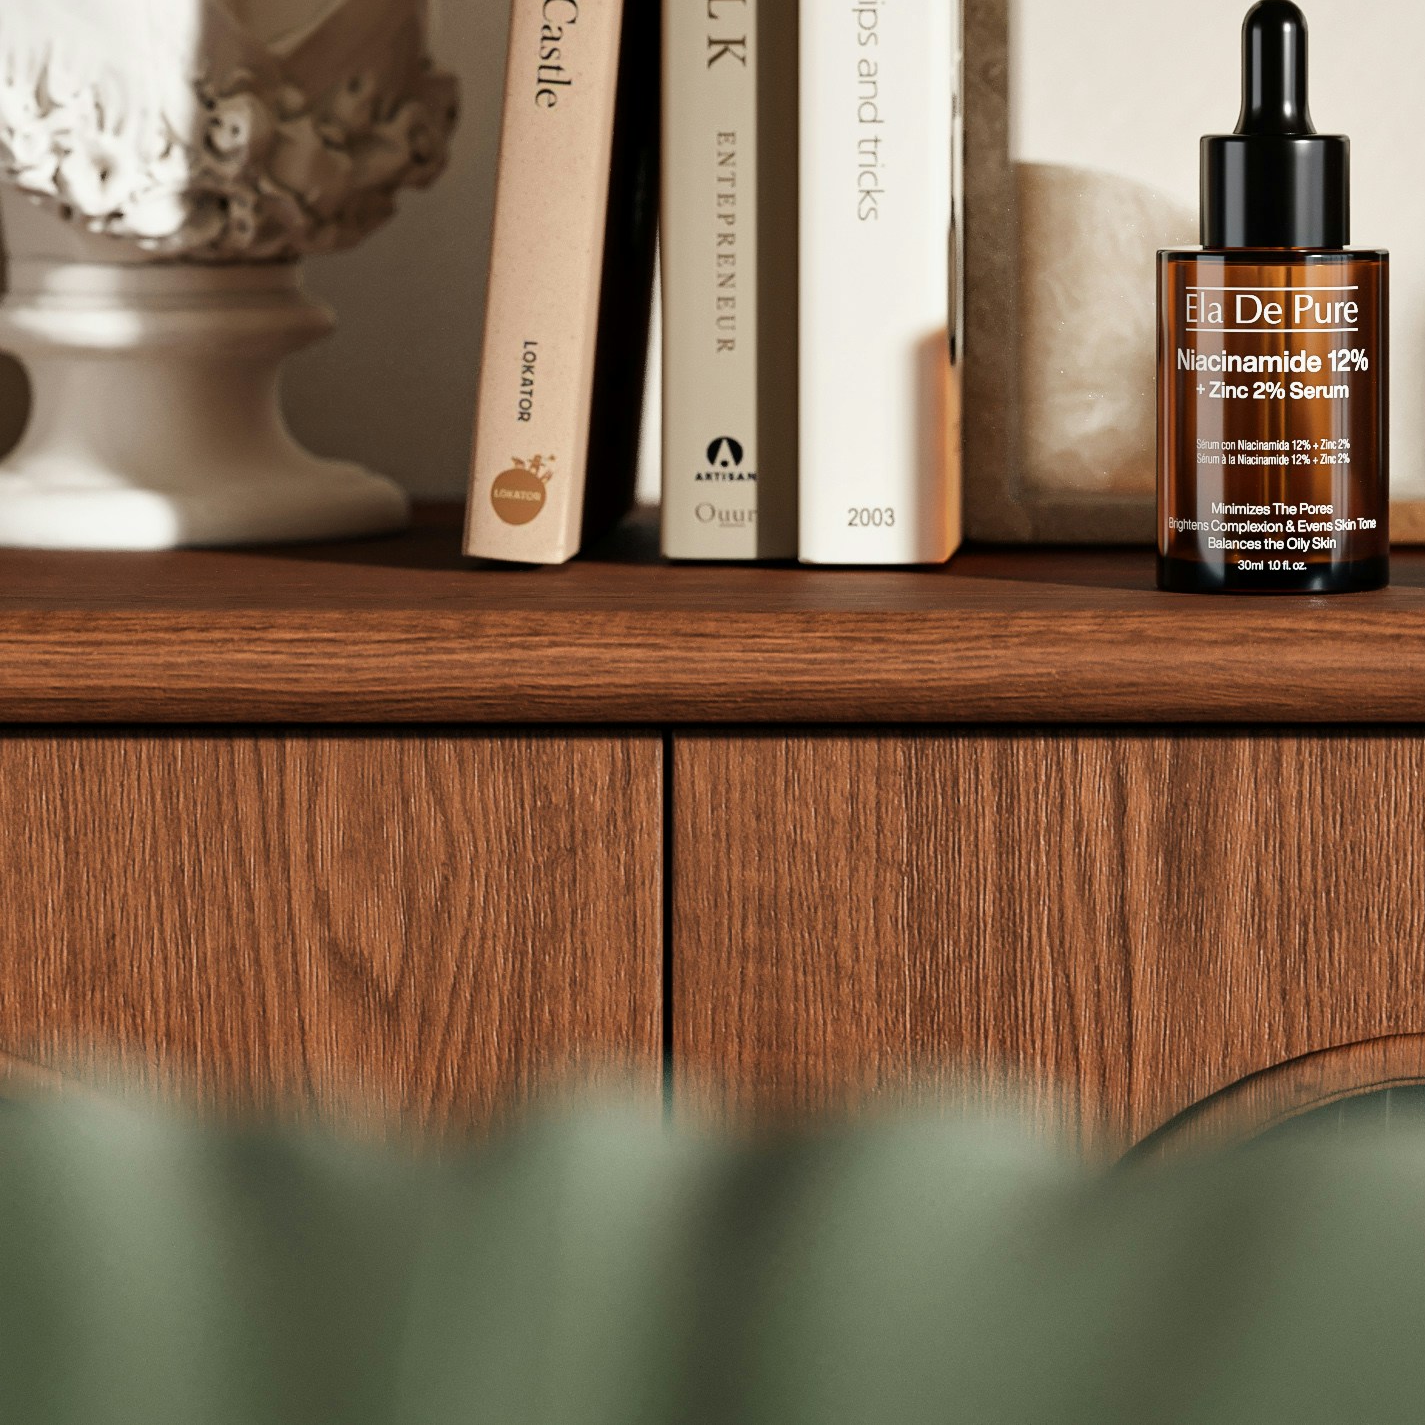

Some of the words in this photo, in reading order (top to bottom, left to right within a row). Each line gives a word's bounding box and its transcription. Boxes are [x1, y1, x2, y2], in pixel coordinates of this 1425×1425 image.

[858, 60, 884, 123] and
[858, 136, 885, 221] tricks
[1186, 291, 1224, 323] Ela
[1236, 294, 1282, 325] De
[1294, 294, 1359, 324] Pure
[1177, 348, 1322, 373] Niacinamide
[1327, 349, 1369, 373] 12%
[518, 341, 538, 422] LOKATOR
[1196, 385, 1205, 395] +
[1209, 382, 1249, 399] Zinc
[1252, 382, 1286, 399] 2%
[1289, 382, 1350, 399] Serum
[1221, 440, 1236, 451] con
[1237, 439, 1290, 451] Niacinamida
[1292, 439, 1311, 451] 12%
[1320, 439, 1337, 451] Zinc
[1338, 438, 1350, 451] 2%
[1228, 454, 1236, 465] la
[1237, 454, 1289, 466] Niacinamide
[1292, 454, 1311, 465] 12%
[1320, 454, 1337, 465] Zinc
[1338, 453, 1350, 465] 2%
[694, 471, 758, 482] ARTISAN
[848, 508, 895, 527] 2003
[1211, 503, 1271, 515] Minimizes
[1273, 503, 1297, 515] The
[1299, 503, 1334, 515] Pores
[1169, 518, 1209, 533] Brightens
[1211, 520, 1284, 535] Complexion
[1286, 520, 1295, 533] &
[1298, 520, 1333, 533] Evens
[1335, 518, 1356, 531] Skin
[1357, 518, 1376, 530] Tone
[1208, 537, 1261, 551] Balances
[1264, 538, 1285, 551] the
[1287, 538, 1310, 553] Oily
[1312, 537, 1337, 550] Skin
[1237, 560, 1264, 571] 30ml
